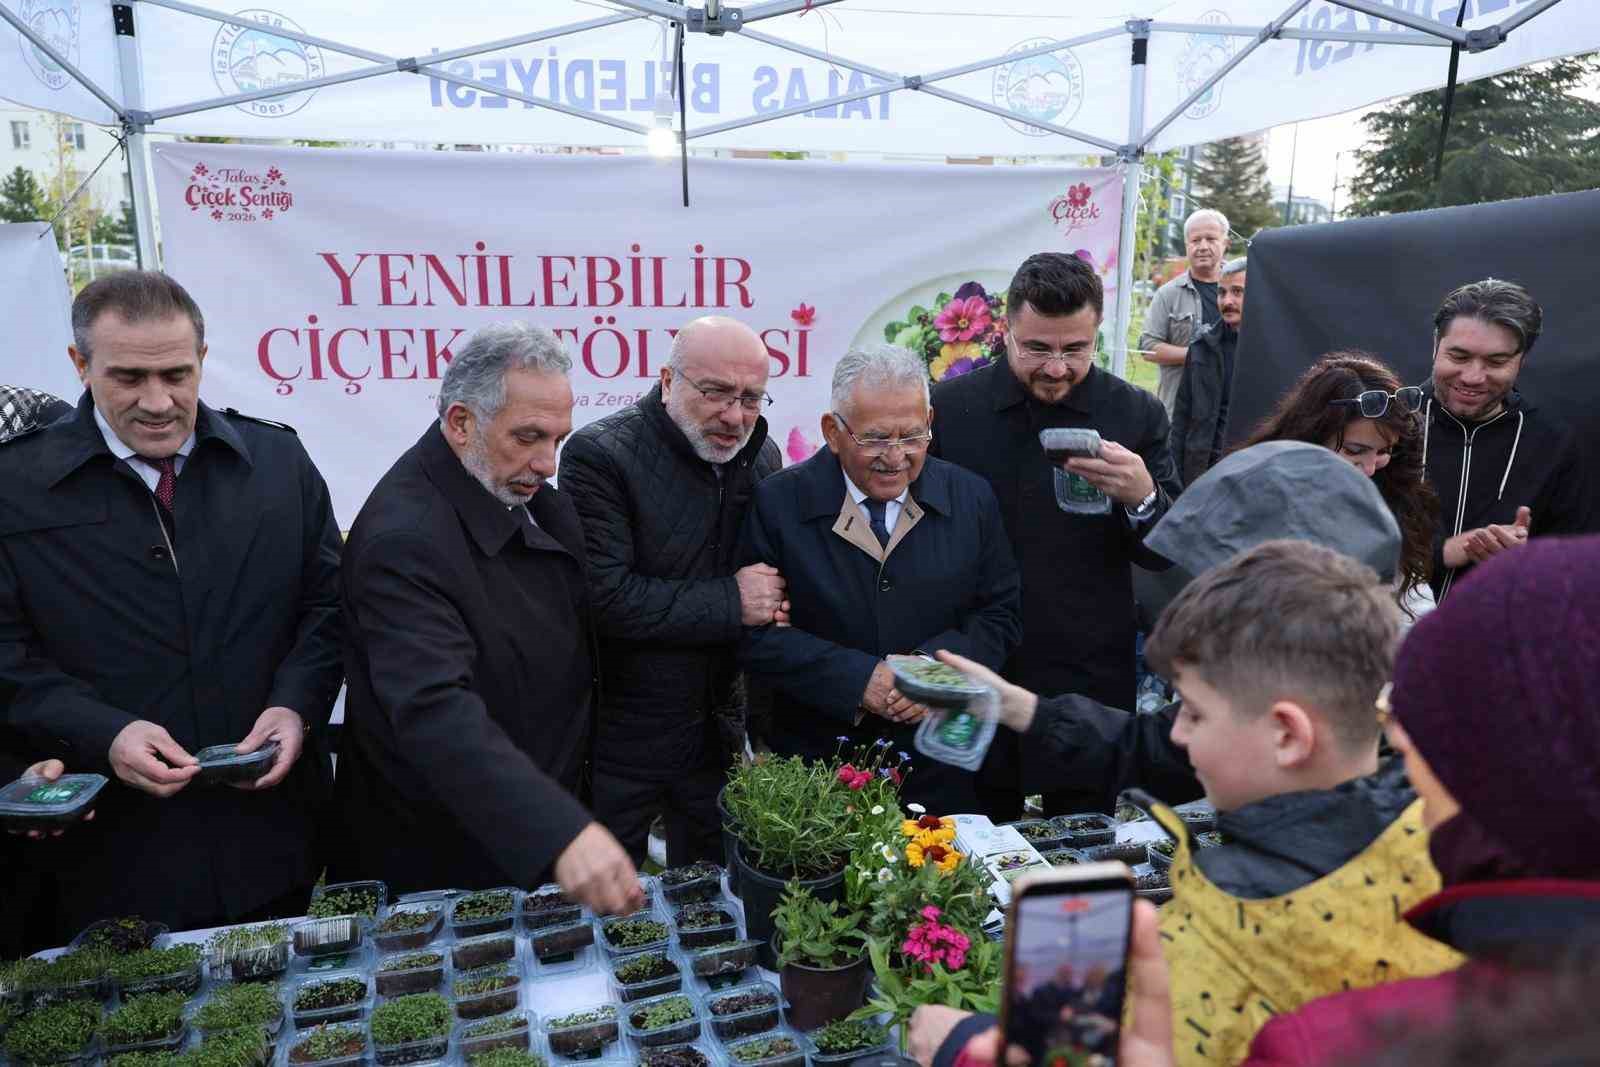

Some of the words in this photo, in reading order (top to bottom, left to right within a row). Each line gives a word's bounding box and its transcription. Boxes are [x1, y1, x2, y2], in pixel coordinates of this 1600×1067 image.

[217, 168, 261, 183] Talas
[185, 184, 237, 211] Çiçek
[1053, 199, 1100, 225] Çiçek
[316, 240, 755, 309] YENİLEBİLİR
[257, 314, 467, 395] ÇİÇEK
